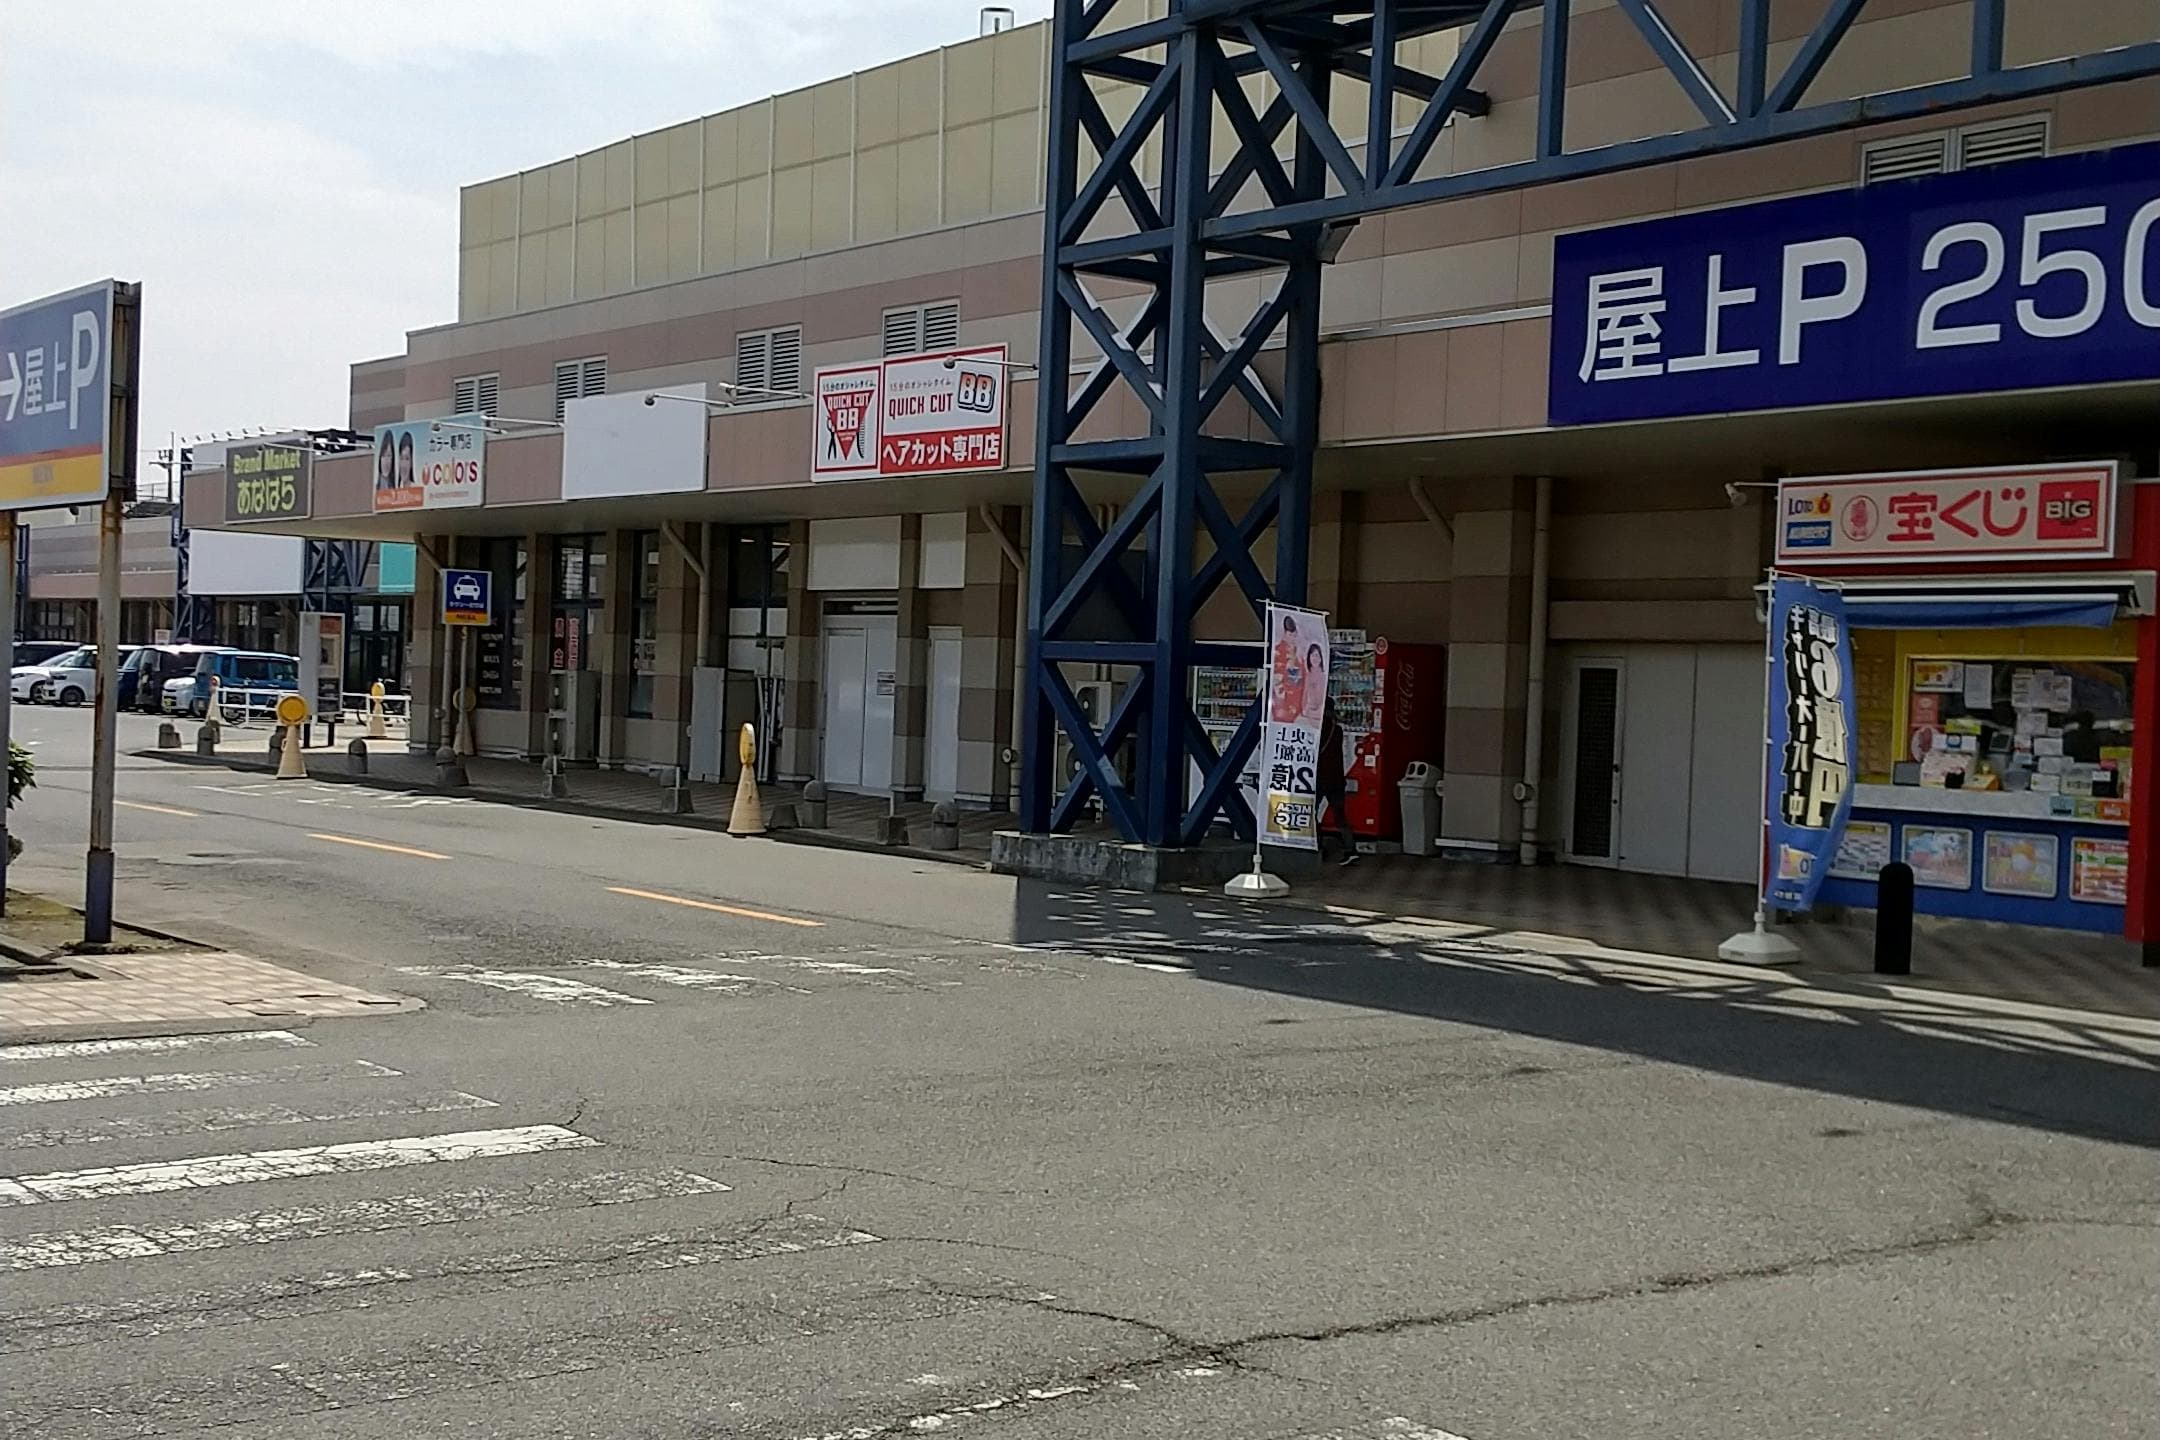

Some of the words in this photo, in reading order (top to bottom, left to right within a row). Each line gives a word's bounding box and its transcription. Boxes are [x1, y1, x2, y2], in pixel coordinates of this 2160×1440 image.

[1578, 236, 1868, 384] 屋上P
[23, 309, 100, 431] 屋上P
[828, 396, 852, 412] QUICK
[853, 392, 870, 408] CUT
[888, 396, 925, 420] QUICK
[930, 393, 954, 413] CUT
[233, 449, 263, 475] Brand
[264, 448, 301, 471] Market
[882, 432, 1001, 467] ヘアカット専門店
[432, 456, 479, 486] colors
[1788, 497, 1815, 516] LOTO
[1818, 492, 1832, 514] 6
[1886, 489, 2029, 542] 宝くじ
